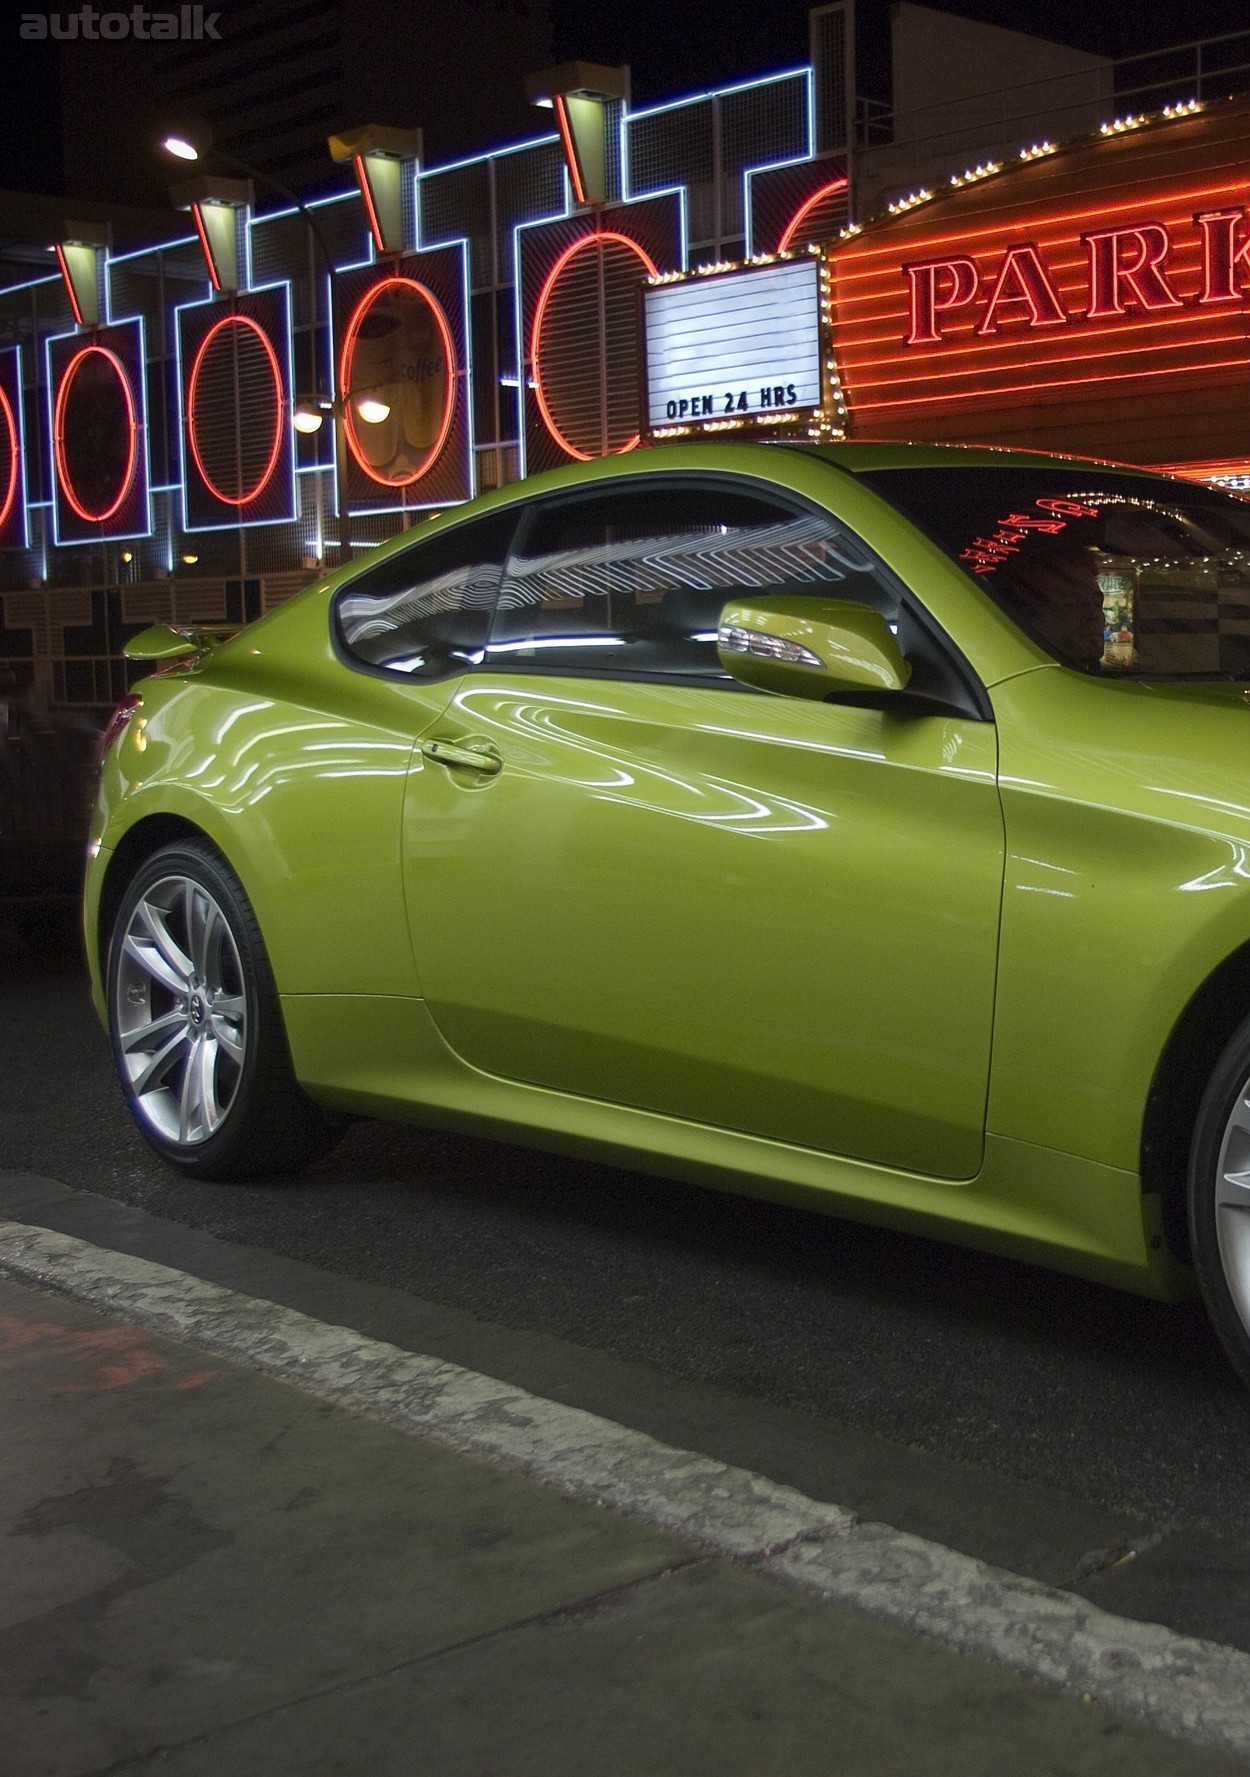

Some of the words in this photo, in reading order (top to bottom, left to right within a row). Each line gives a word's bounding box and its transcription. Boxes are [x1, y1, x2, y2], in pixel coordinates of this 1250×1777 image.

[667, 394, 713, 419] OPEN
[724, 391, 748, 413] 24
[760, 384, 797, 408] HRS
